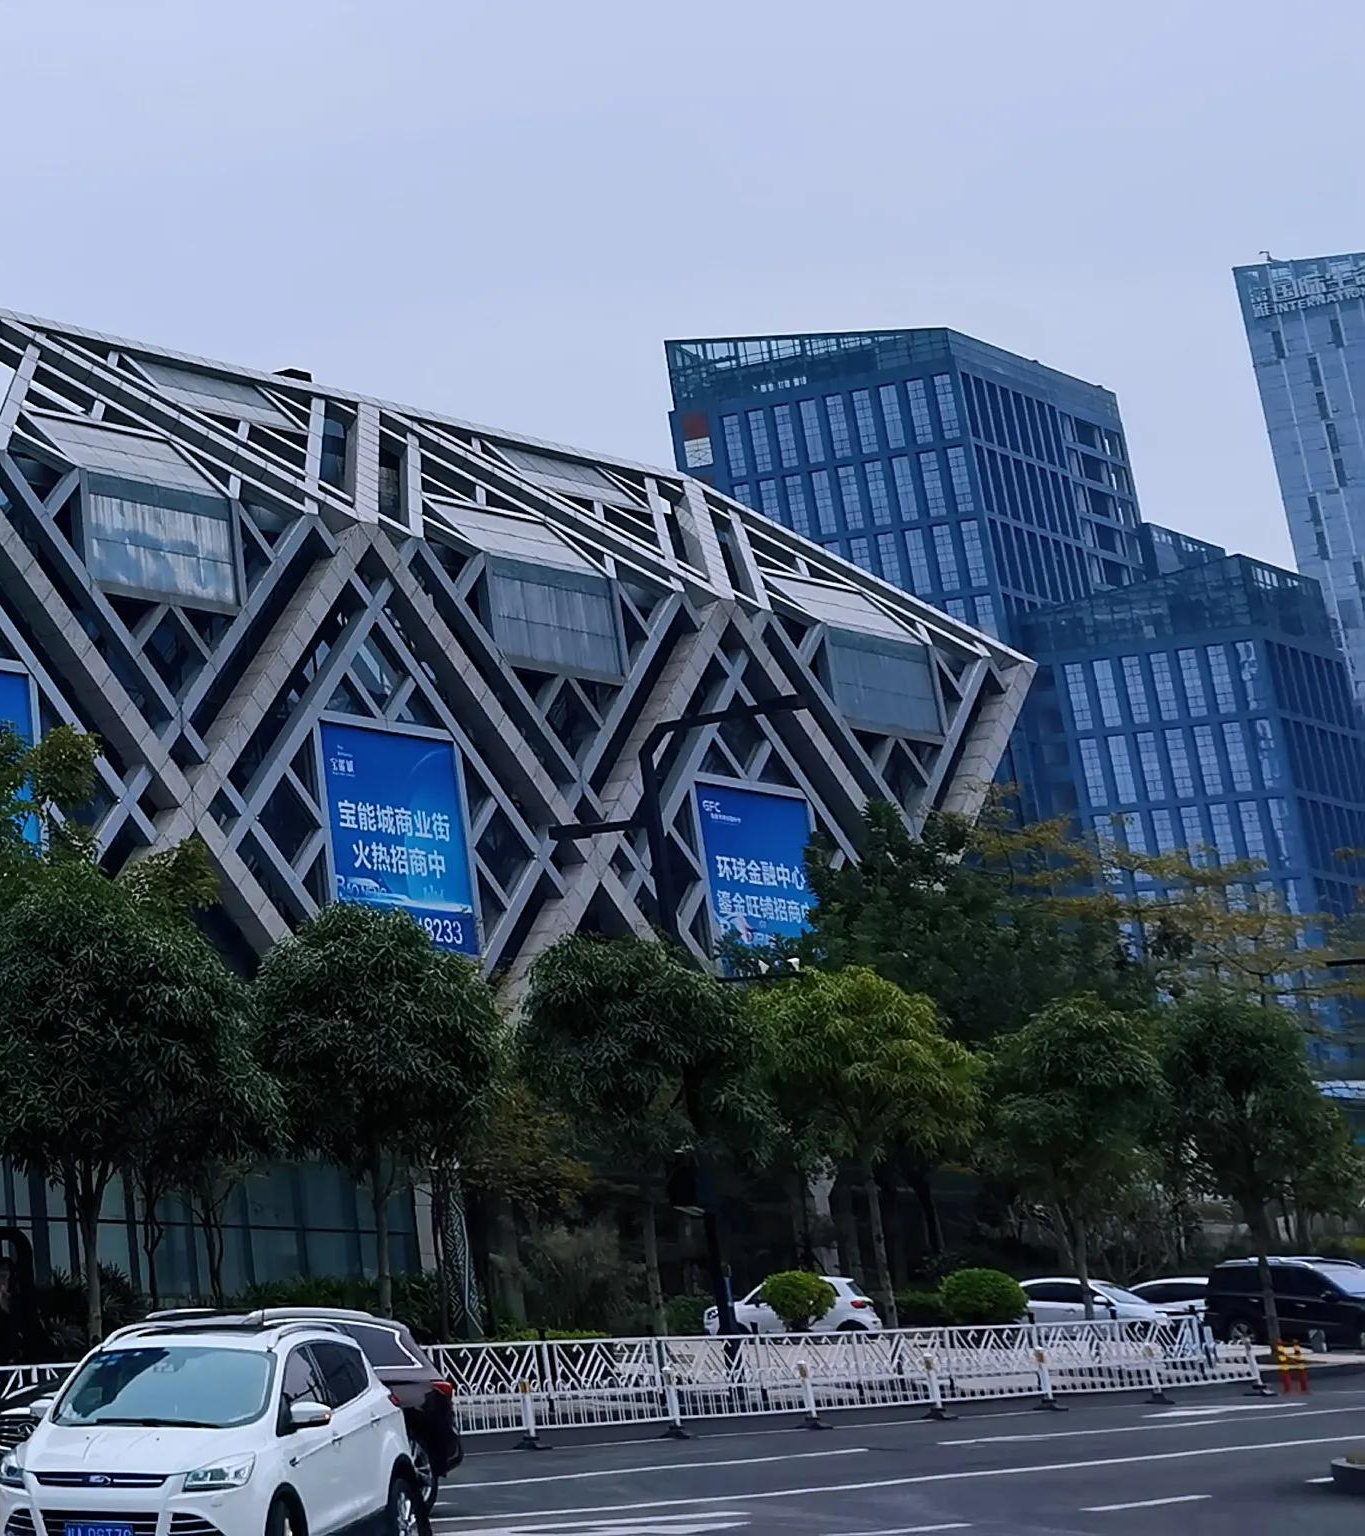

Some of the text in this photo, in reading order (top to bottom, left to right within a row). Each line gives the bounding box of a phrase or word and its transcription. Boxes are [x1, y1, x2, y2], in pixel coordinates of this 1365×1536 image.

[338, 800, 450, 842] 宝能城商业街
[352, 839, 447, 879] 火热招商中
[716, 855, 807, 891] 环球金融中心
[419, 917, 463, 945] 8233
